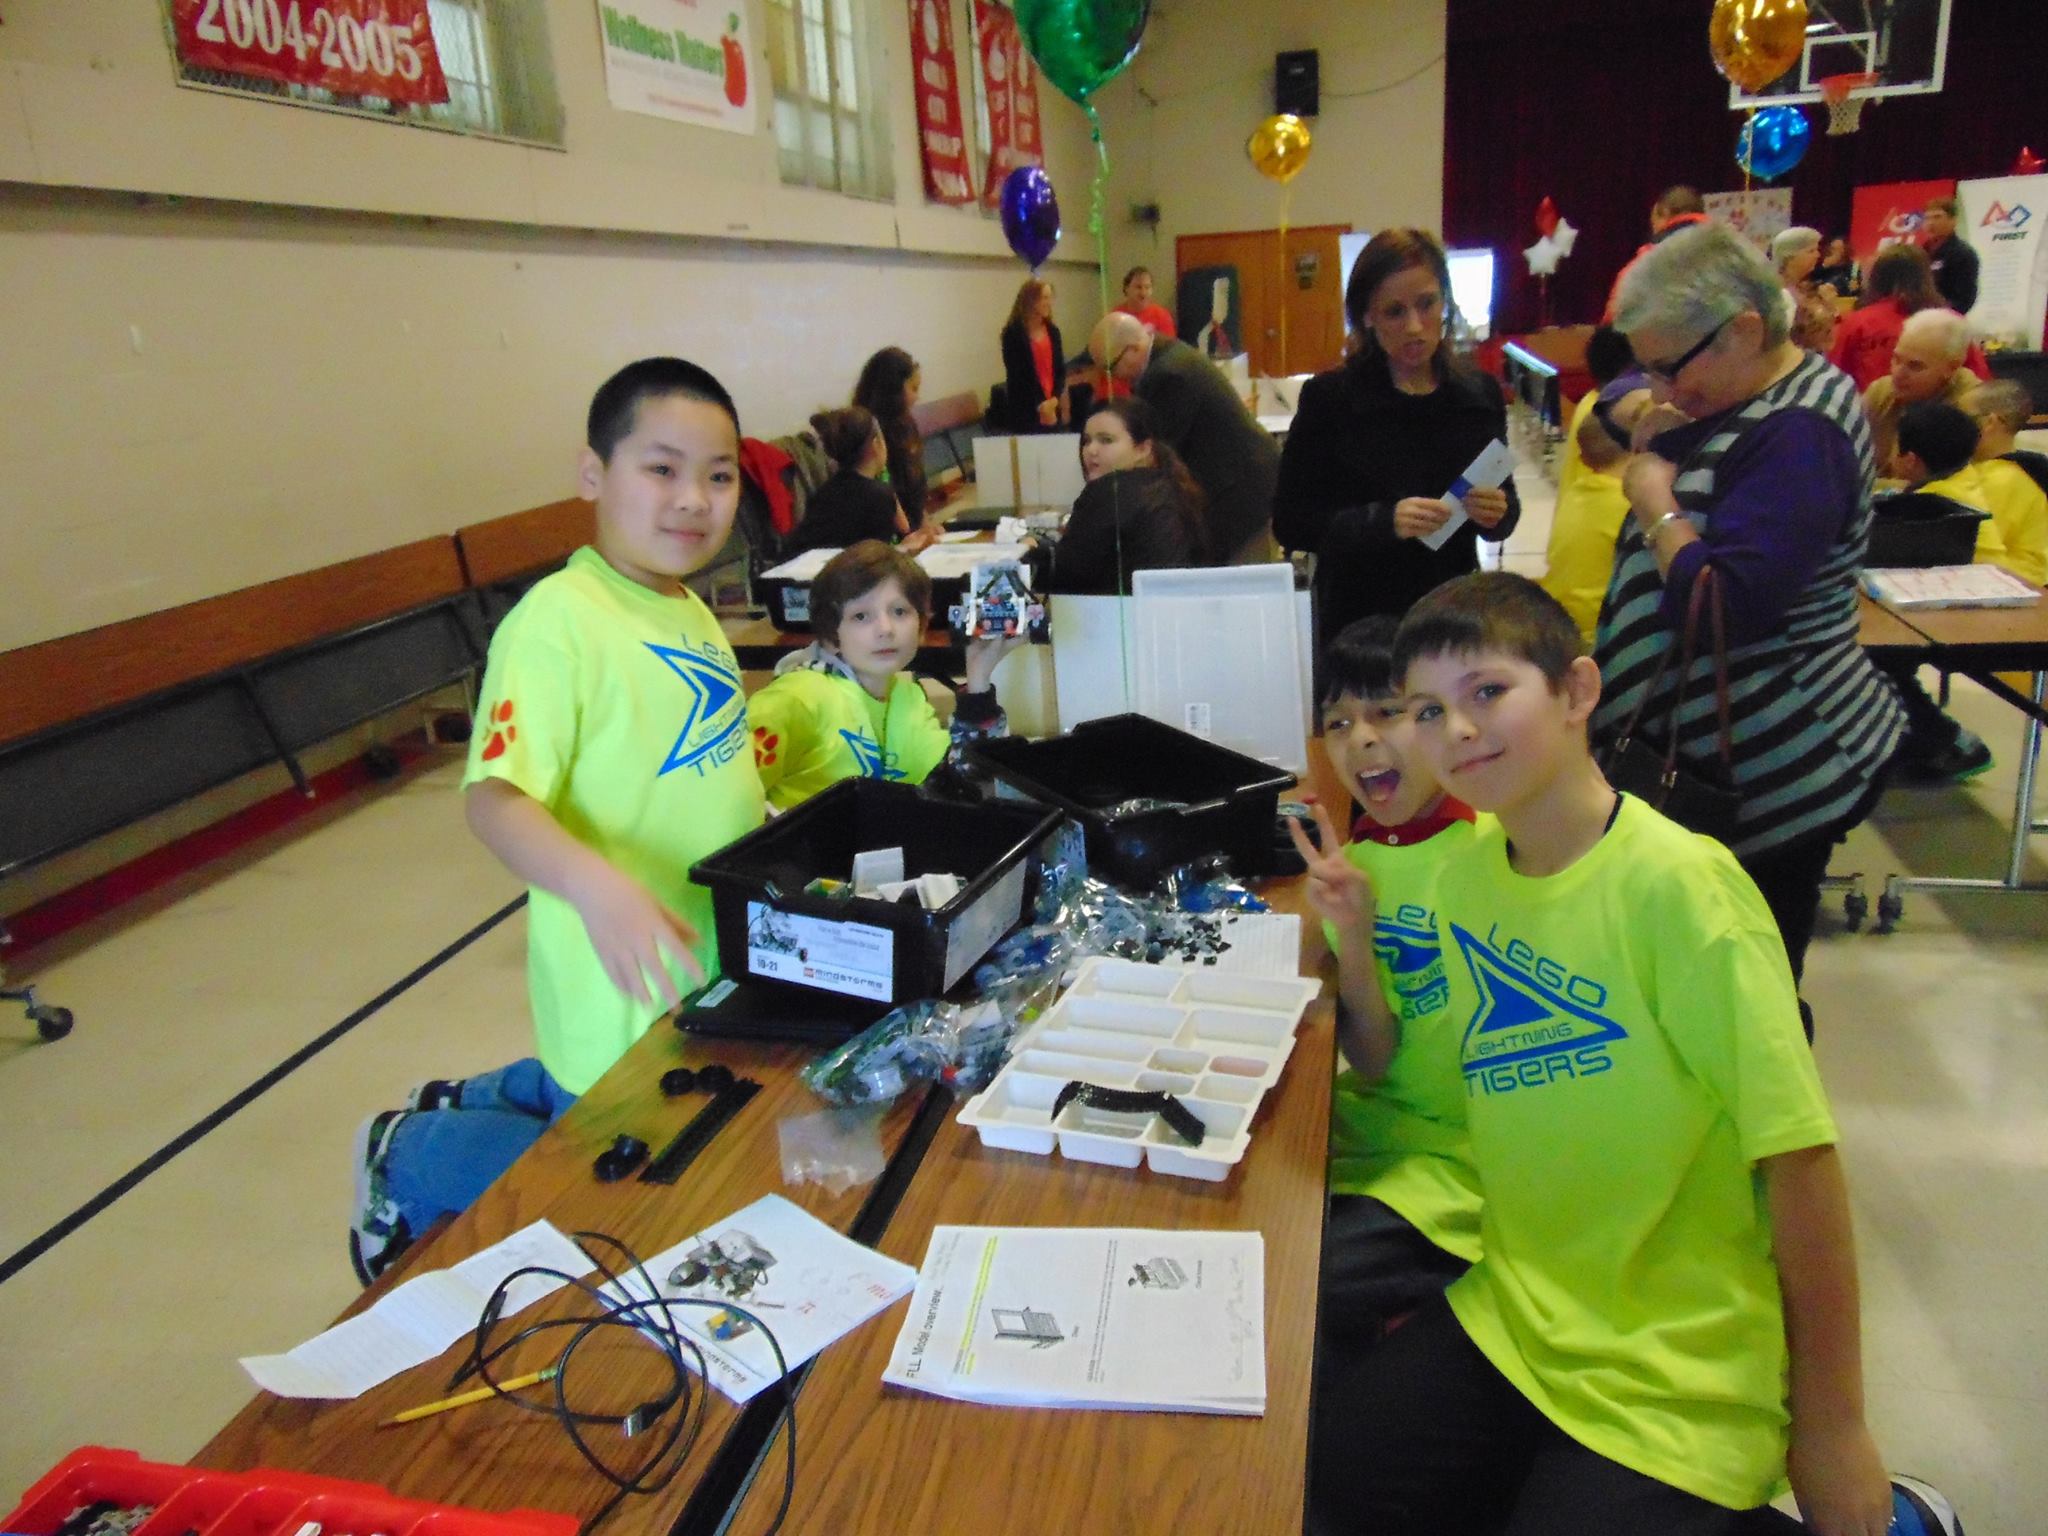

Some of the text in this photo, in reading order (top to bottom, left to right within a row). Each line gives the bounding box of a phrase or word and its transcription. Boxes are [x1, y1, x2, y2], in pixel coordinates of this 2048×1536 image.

[196, 0, 422, 81] 2004-2005
[1992, 231, 2028, 241] FIRST
[1466, 1022, 1573, 1059] LIGHTNING
[906, 1359, 922, 1378] FLL
